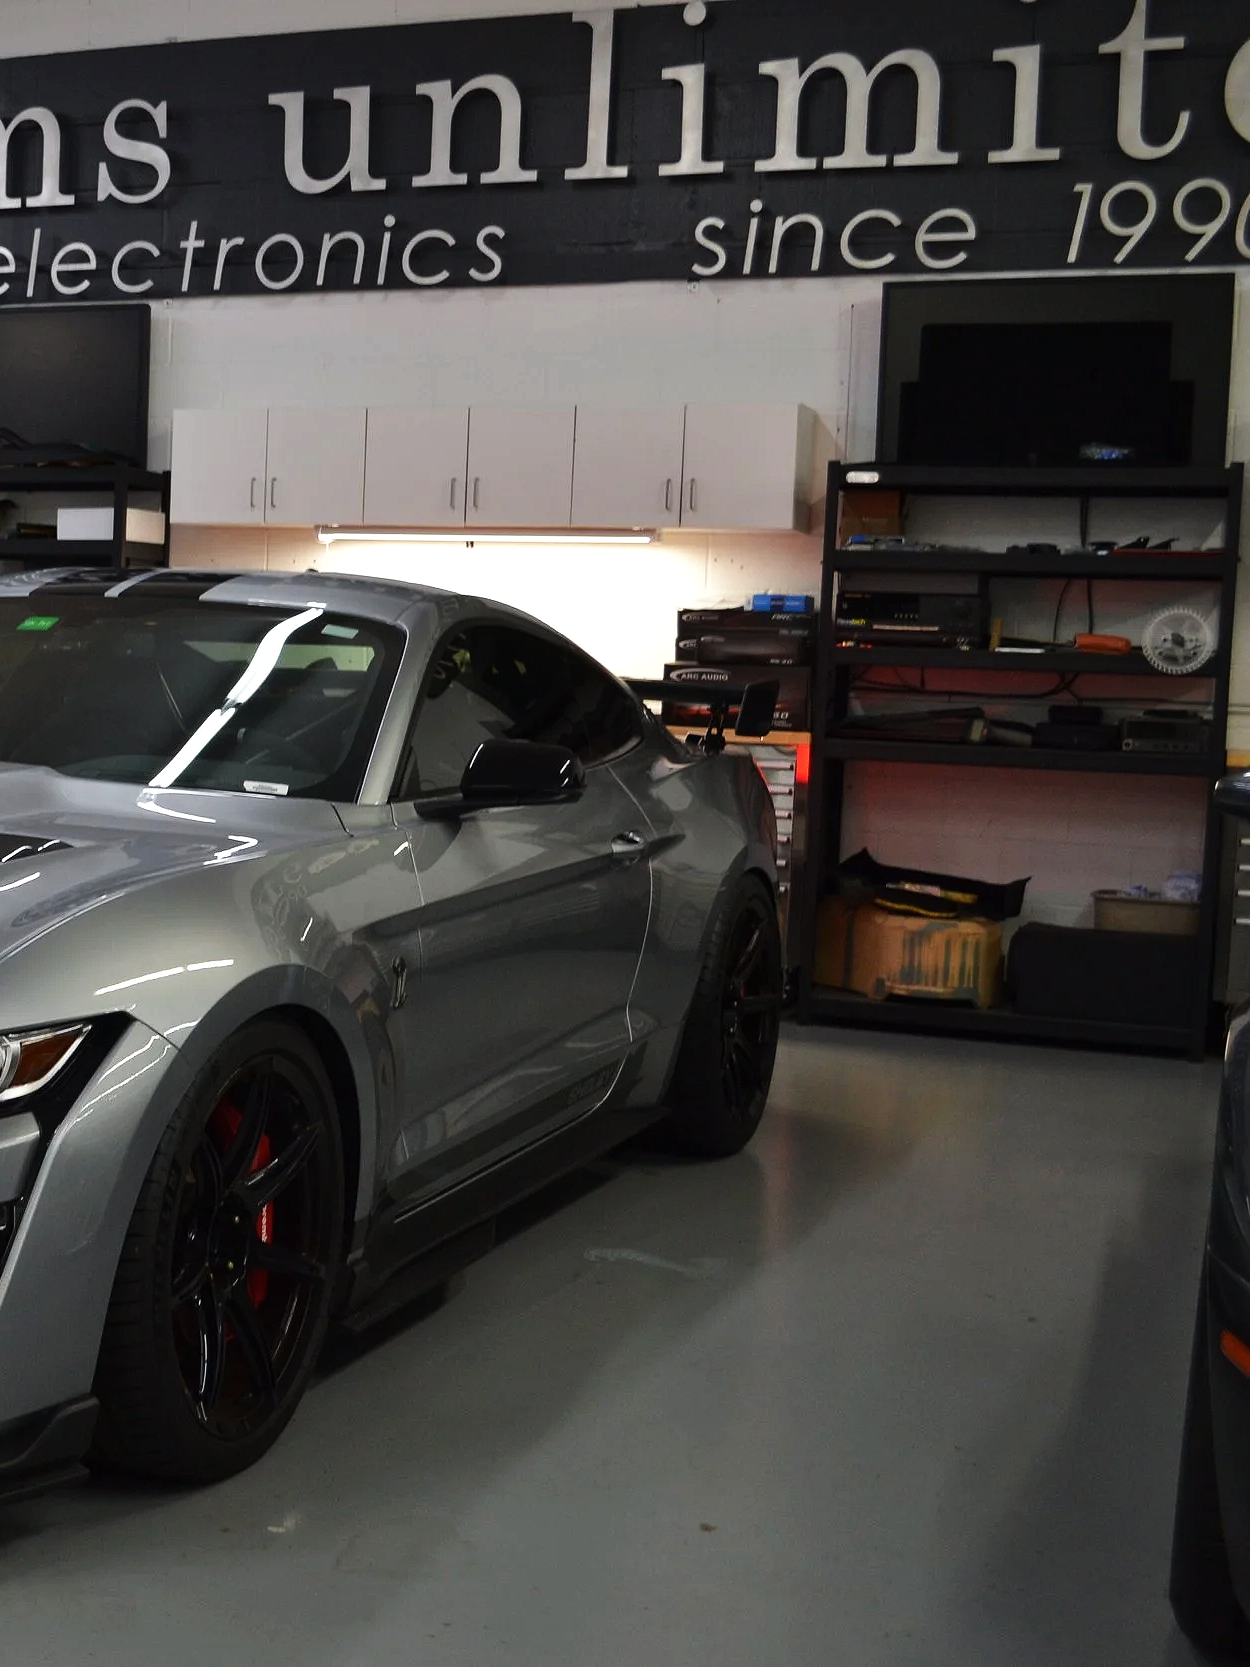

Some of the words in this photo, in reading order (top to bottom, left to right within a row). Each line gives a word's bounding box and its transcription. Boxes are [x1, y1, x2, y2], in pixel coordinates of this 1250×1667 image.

[268, 0, 1250, 194] unlimit
[691, 198, 976, 276] since
[1066, 178, 1250, 264] 199
